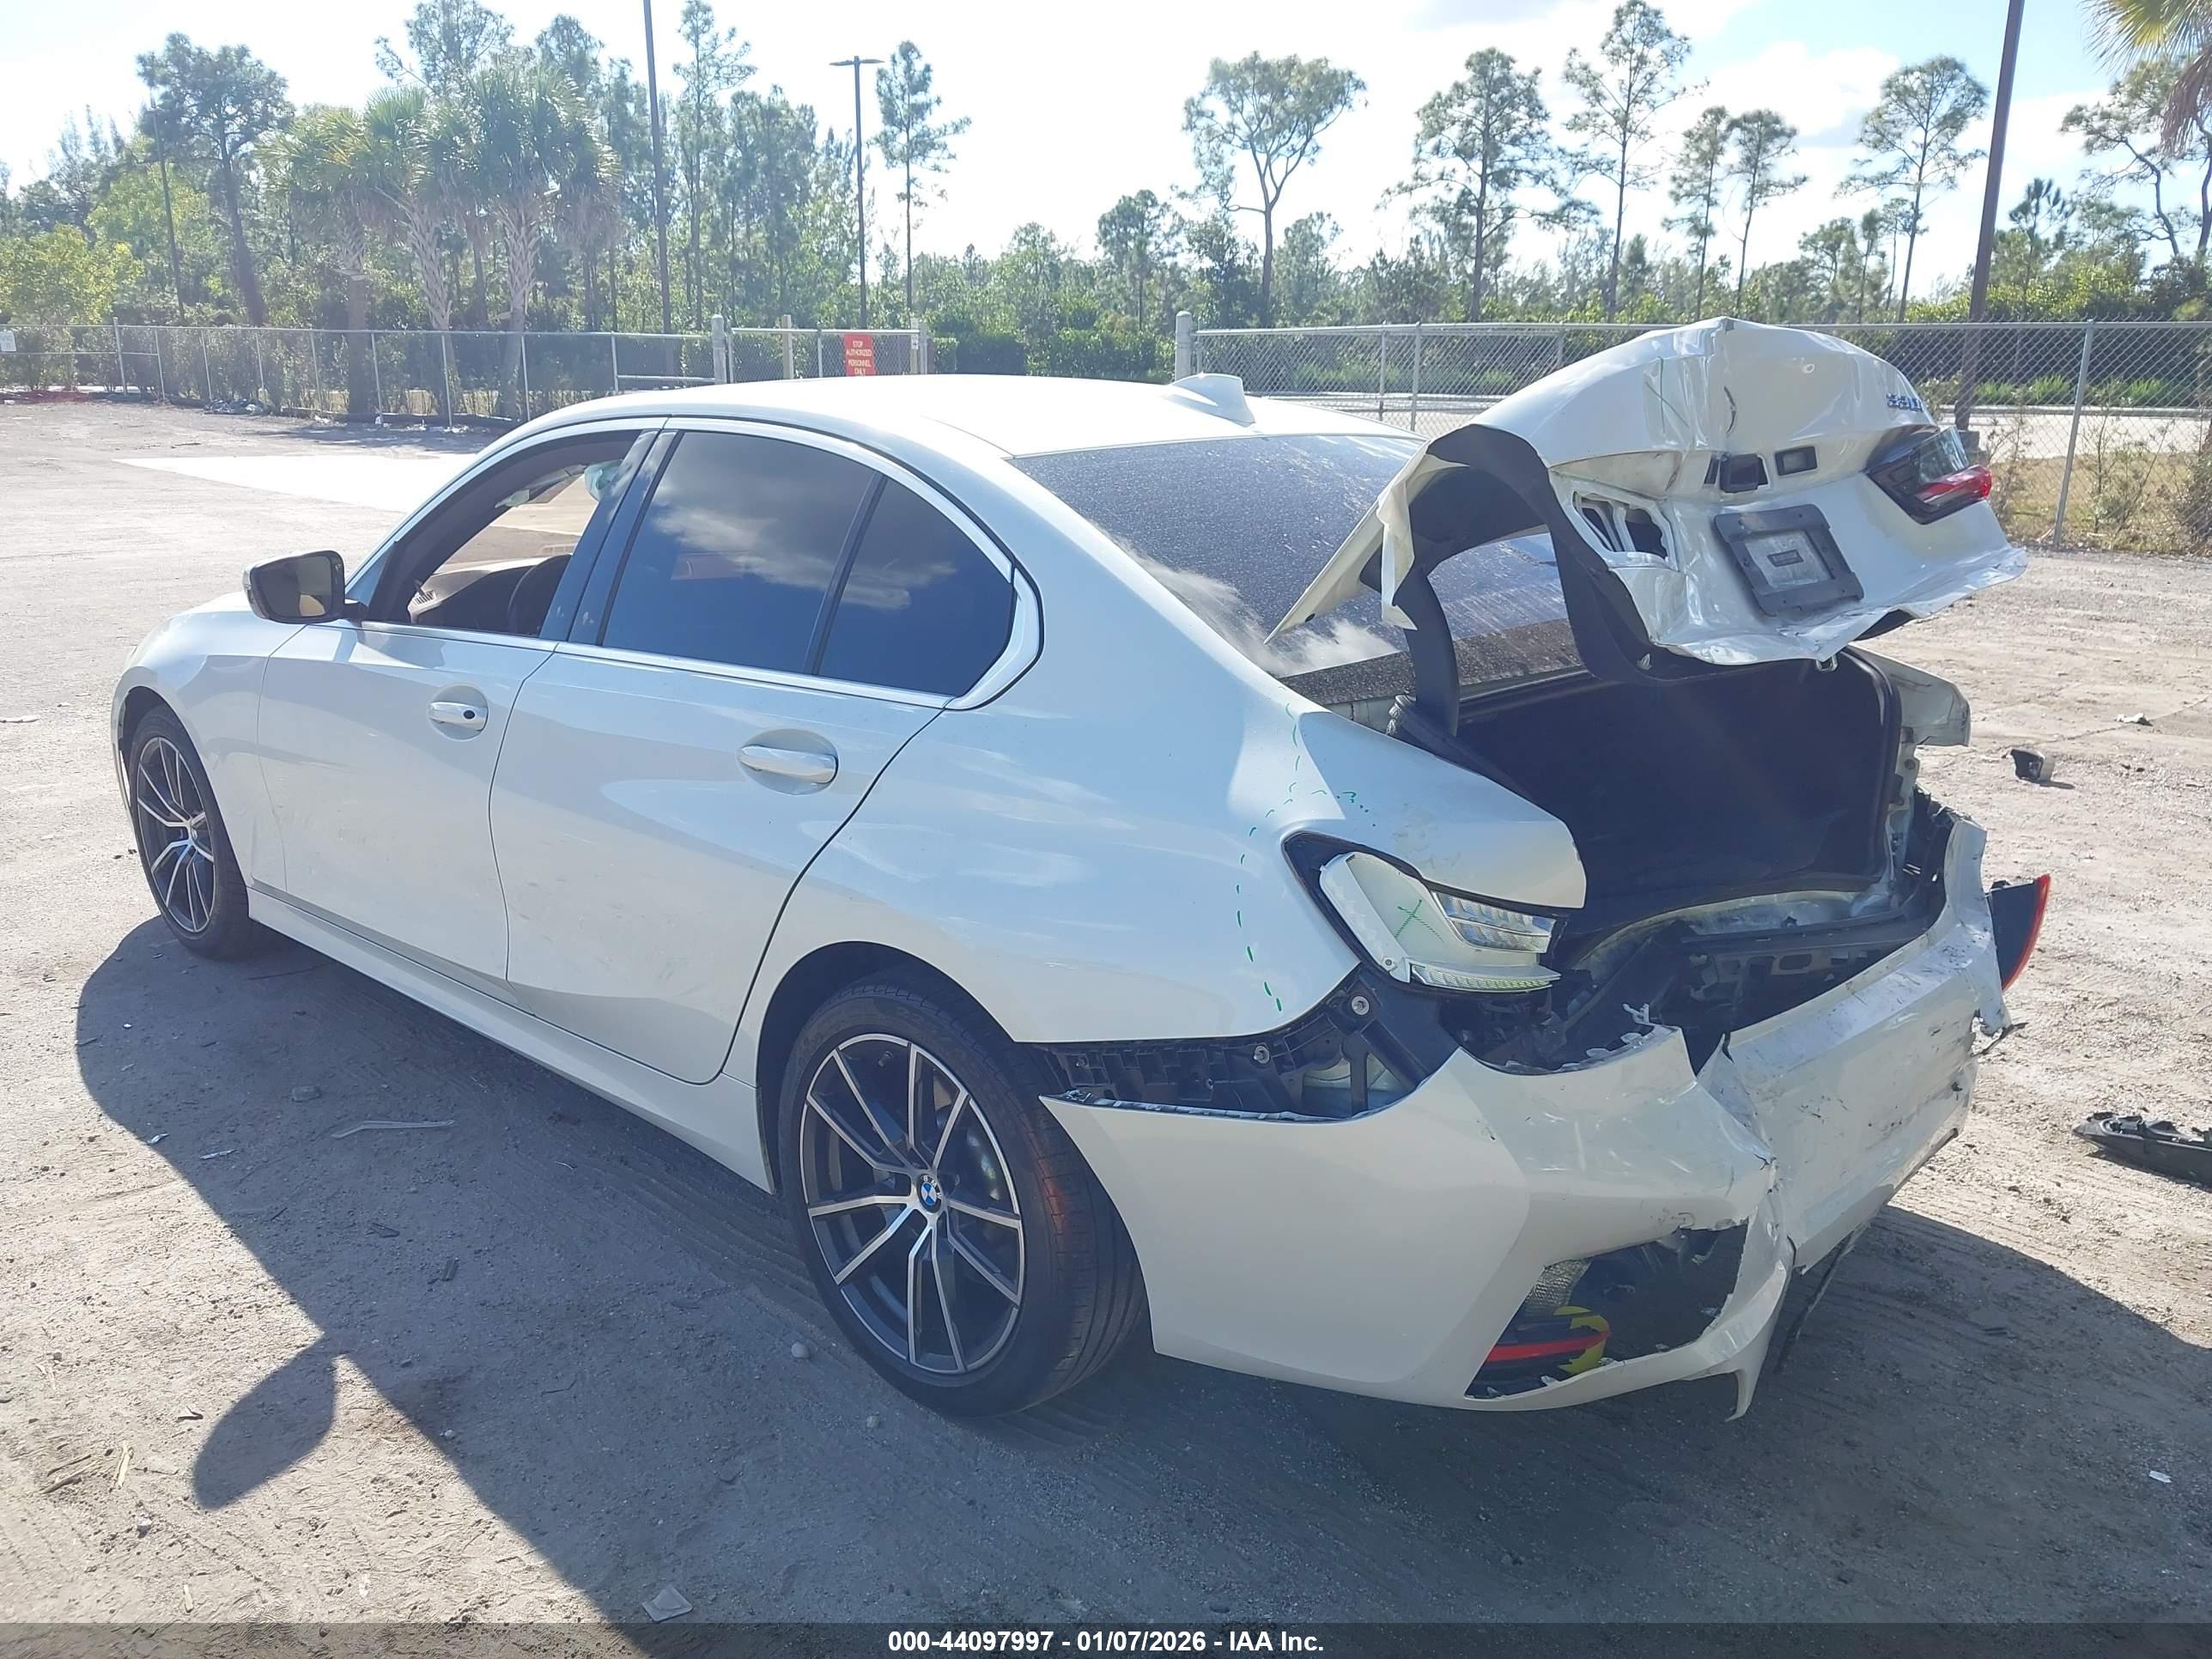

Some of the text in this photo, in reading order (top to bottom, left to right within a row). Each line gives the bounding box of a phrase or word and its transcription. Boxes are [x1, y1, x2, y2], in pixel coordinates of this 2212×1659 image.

[846, 349, 872, 357] AUTHORIZED
[848, 359, 872, 368] PERSONNEL
[923, 1175, 942, 1200] BMW
